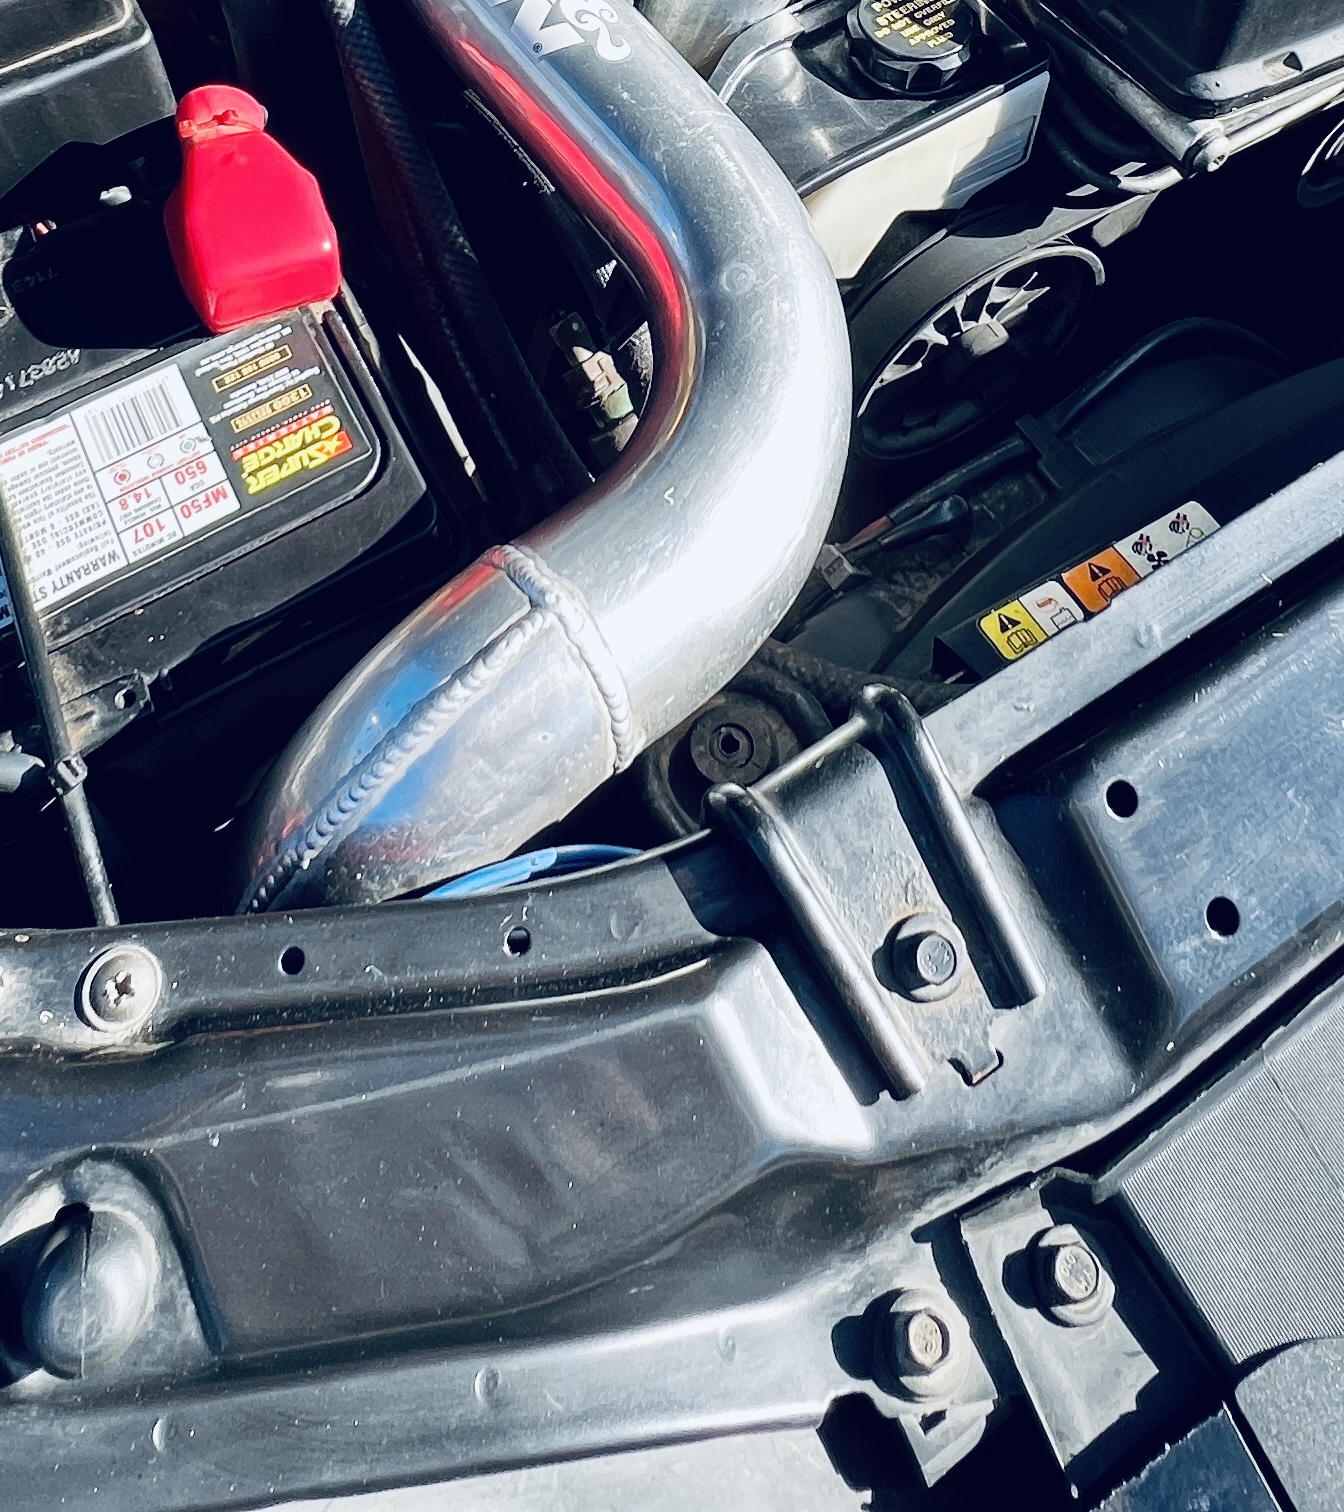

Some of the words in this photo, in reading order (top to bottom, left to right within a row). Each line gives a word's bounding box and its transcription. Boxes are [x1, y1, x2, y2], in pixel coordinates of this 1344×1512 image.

[873, 26, 891, 39] DO
[890, 16, 913, 32] NOT
[908, 18, 956, 47] APPROVED
[270, 386, 310, 412] 1300
[236, 412, 343, 476] CHARGE
[172, 459, 208, 486] 650
[241, 439, 332, 498] SUPER
[117, 485, 153, 511] 14.8
[189, 479, 205, 491] CCA
[80, 500, 100, 515] TAXI
[178, 484, 229, 520] MF50
[49, 509, 104, 541] COMMERCIAL
[64, 510, 80, 523] USE
[73, 518, 107, 539] PRIVATE
[30, 536, 47, 550] USE
[54, 535, 71, 548] USE
[130, 516, 166, 544] 107
[131, 536, 165, 557] MINUTES
[48, 548, 121, 594] WARRANTY
